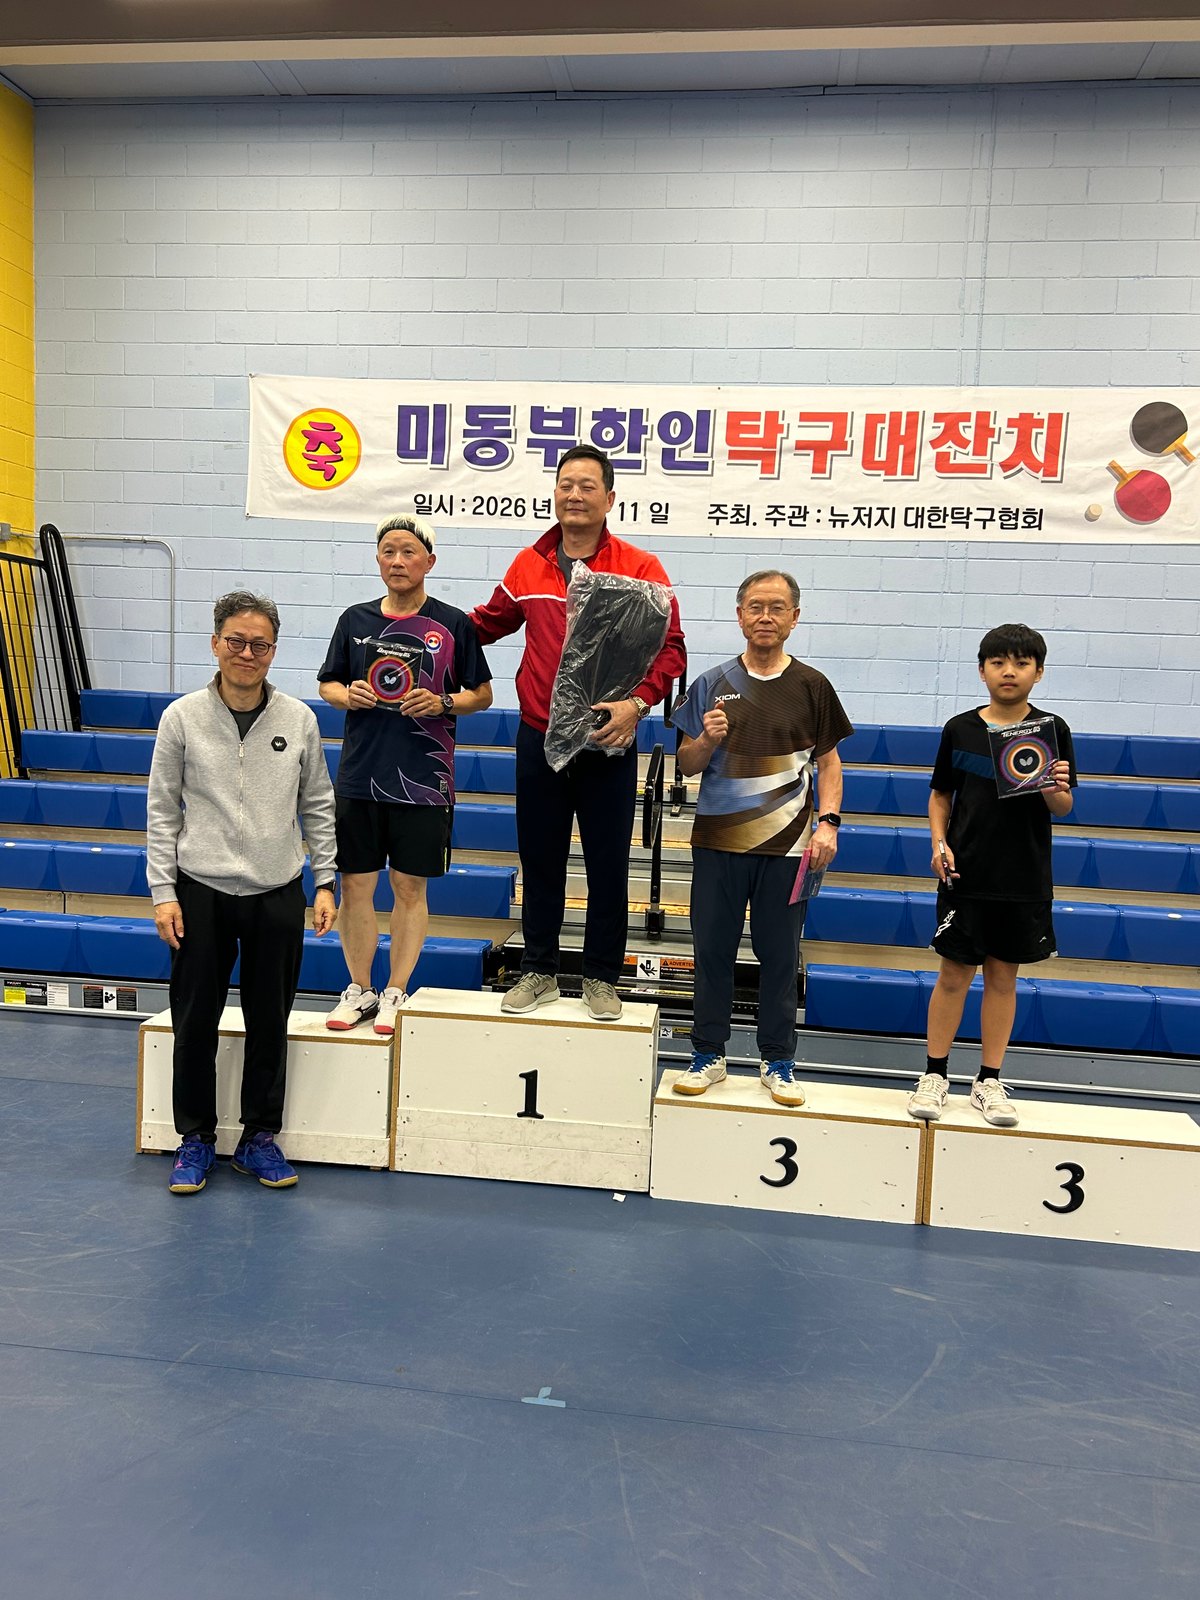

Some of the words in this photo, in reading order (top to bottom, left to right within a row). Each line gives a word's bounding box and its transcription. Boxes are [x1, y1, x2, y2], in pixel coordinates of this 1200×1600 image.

[301, 421, 343, 481] 축
[472, 495, 526, 518] 2026
[532, 497, 552, 520] 년
[618, 501, 639, 522] 11
[649, 502, 671, 524] 일
[828, 505, 896, 529] 뉴저지
[903, 506, 1044, 531] 대한탁구협회
[714, 693, 741, 703] XIOM
[516, 1069, 545, 1120] 1
[759, 1137, 799, 1188] 3
[1042, 1162, 1085, 1214] 3
